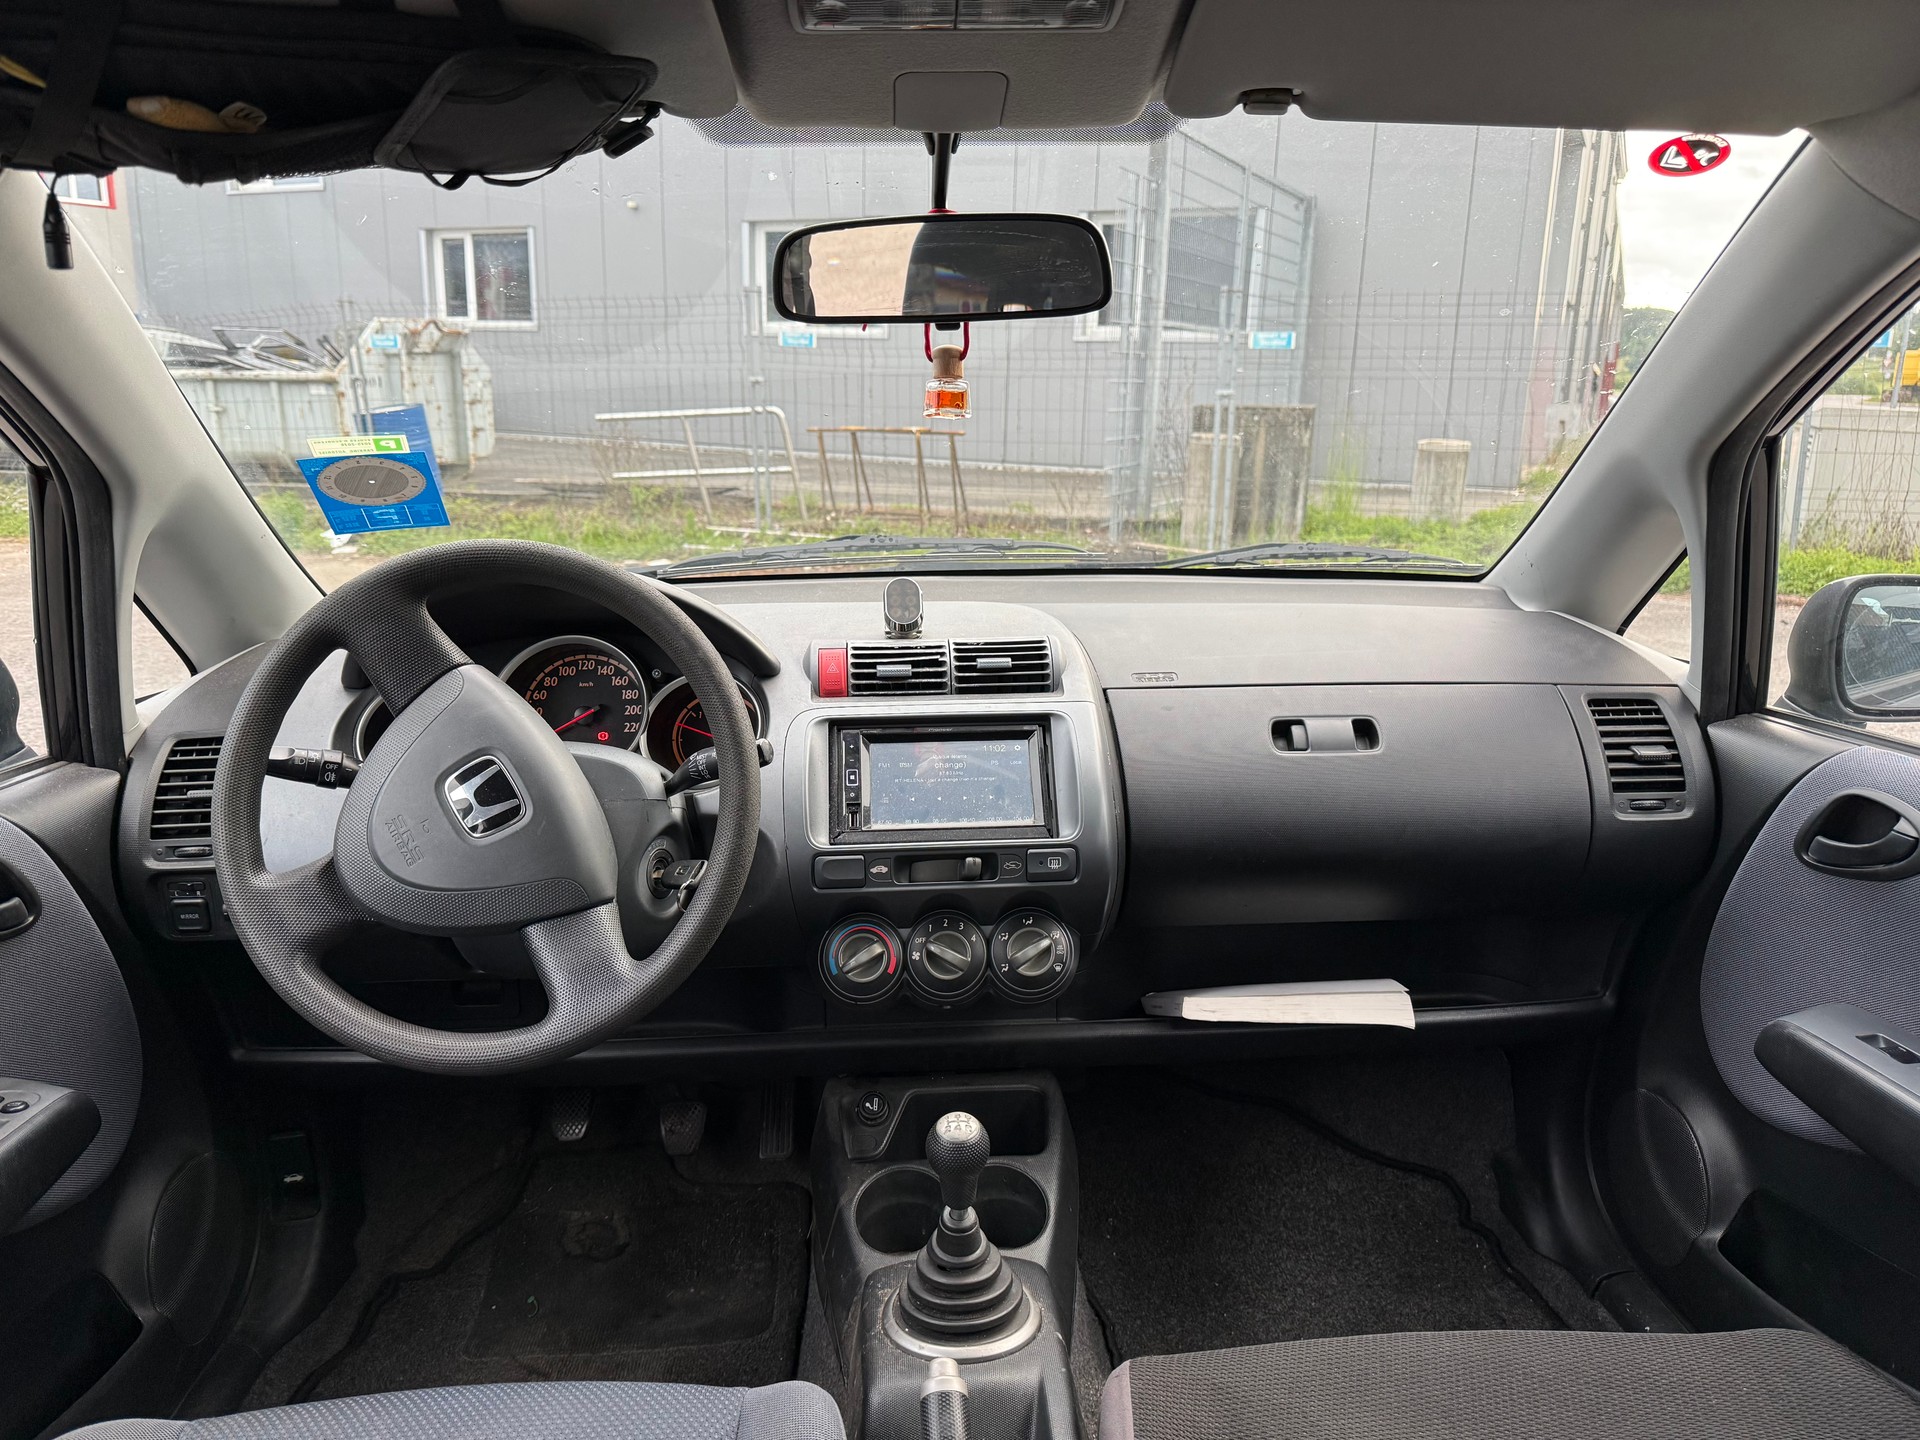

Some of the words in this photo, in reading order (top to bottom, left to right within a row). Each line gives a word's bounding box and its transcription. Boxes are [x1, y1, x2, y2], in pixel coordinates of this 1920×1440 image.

[578, 660, 596, 670] 120
[559, 666, 577, 676] 100
[597, 665, 615, 676] 140
[543, 676, 558, 687] 80
[611, 676, 629, 686] 160
[532, 690, 547, 700] 60
[621, 689, 639, 700] 180
[624, 705, 642, 715] 200
[983, 744, 1006, 752] 11:02
[385, 822, 414, 867] AIRBAG
[928, 924, 932, 932] 1
[943, 919, 948, 927] 2
[958, 922, 964, 930] 3
